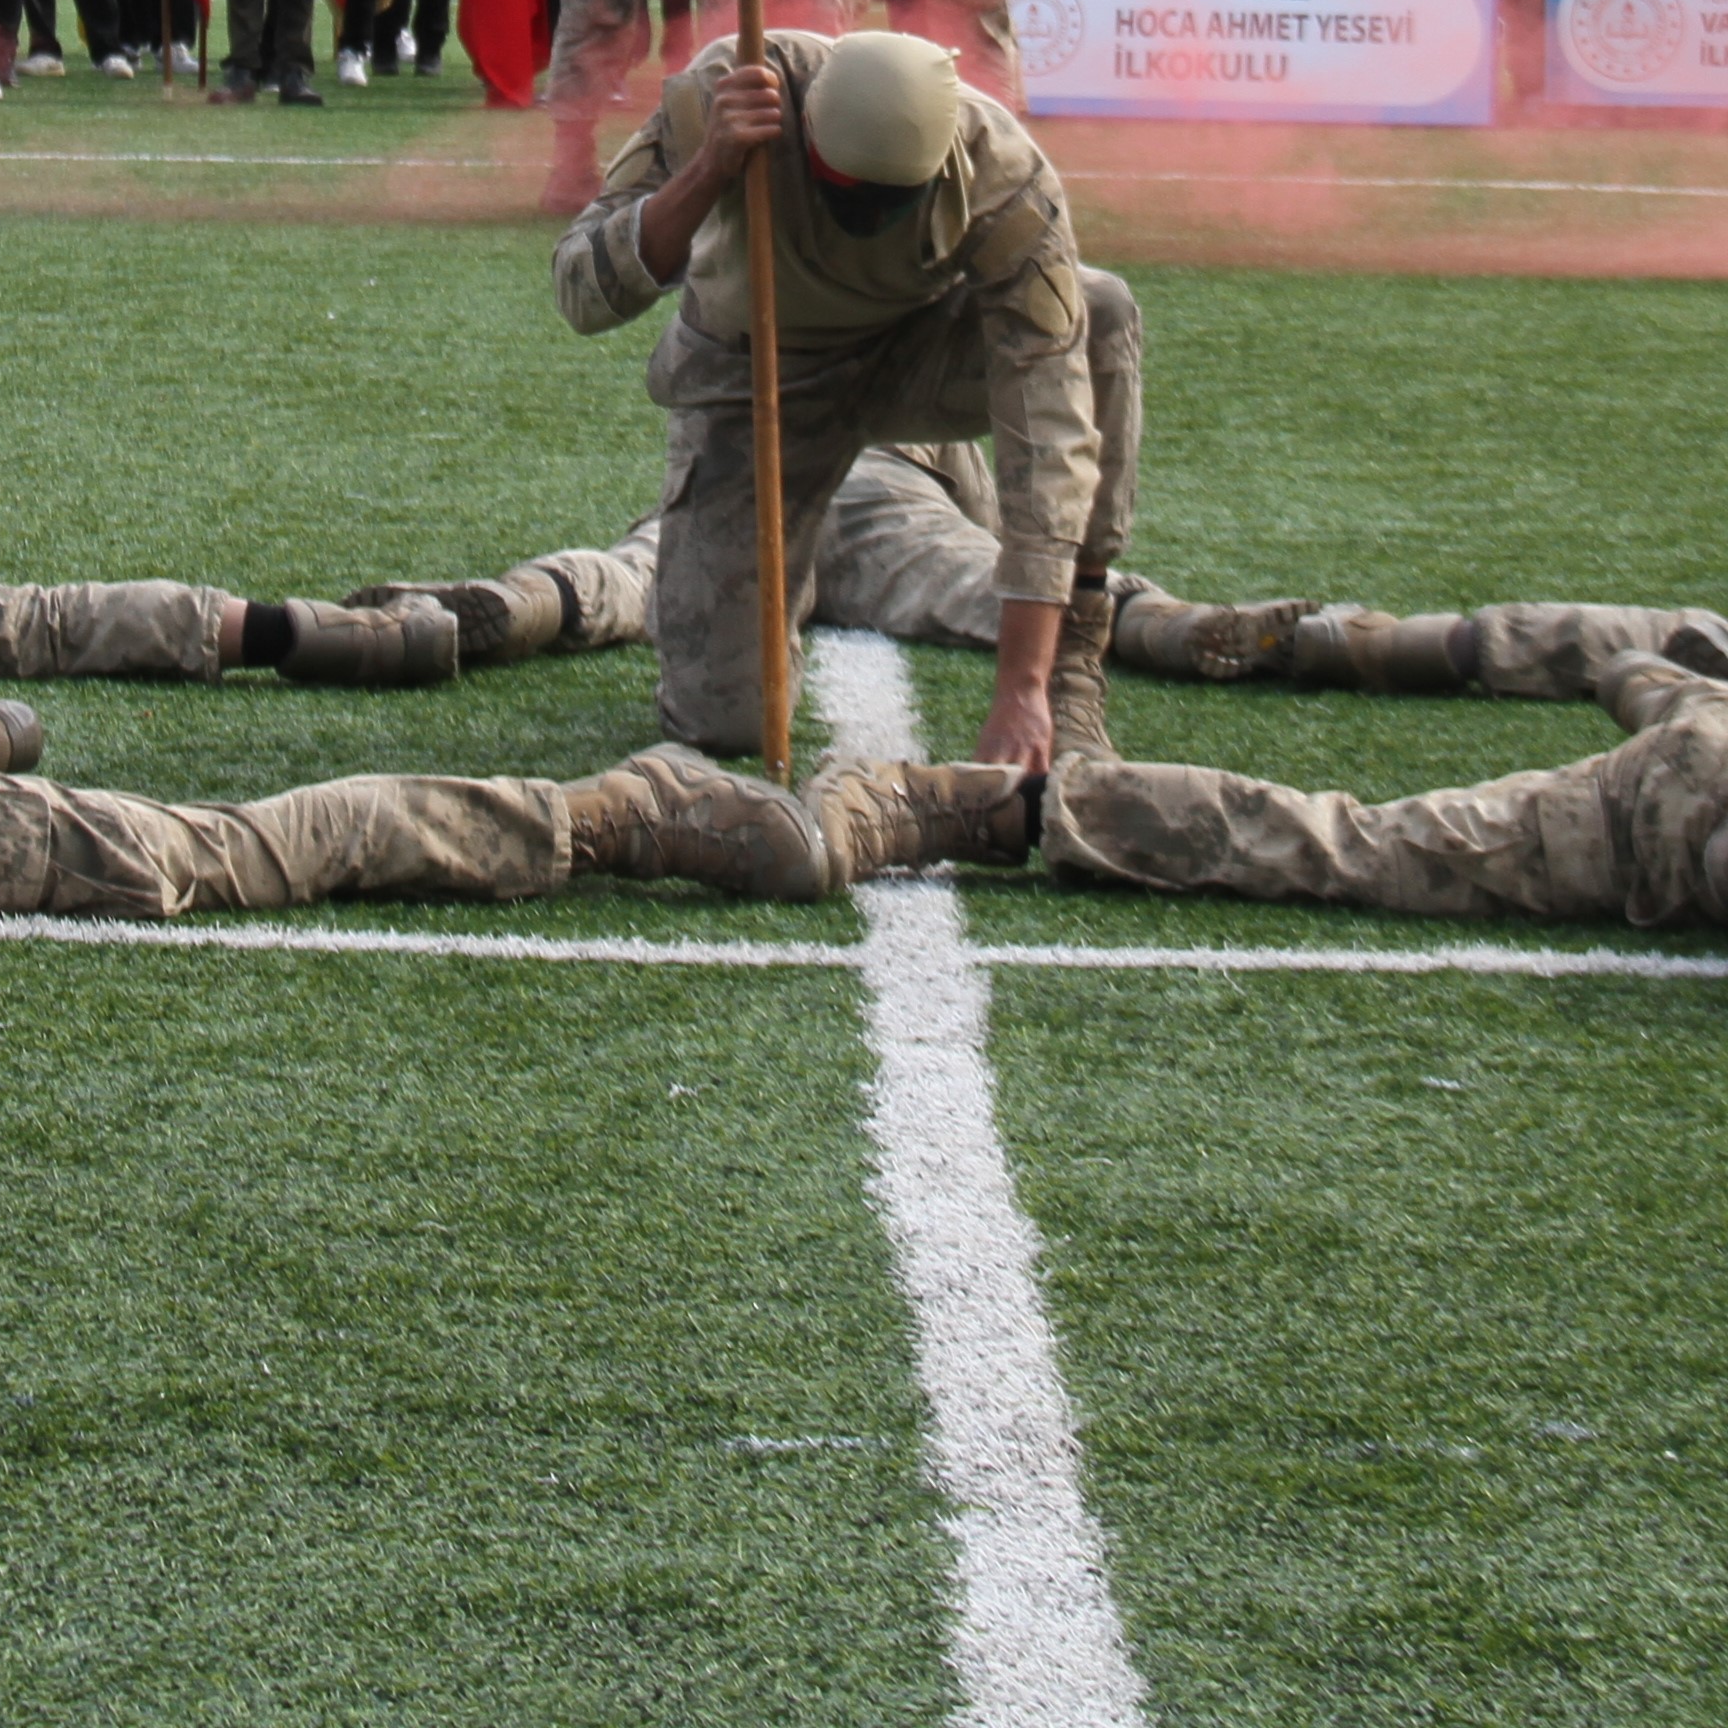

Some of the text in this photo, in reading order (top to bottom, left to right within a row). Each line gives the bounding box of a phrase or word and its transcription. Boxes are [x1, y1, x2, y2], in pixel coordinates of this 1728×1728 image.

[1115, 9, 1416, 44] HOCA AHMET YESEVİ
[1114, 43, 1289, 82] İLKOKULU
